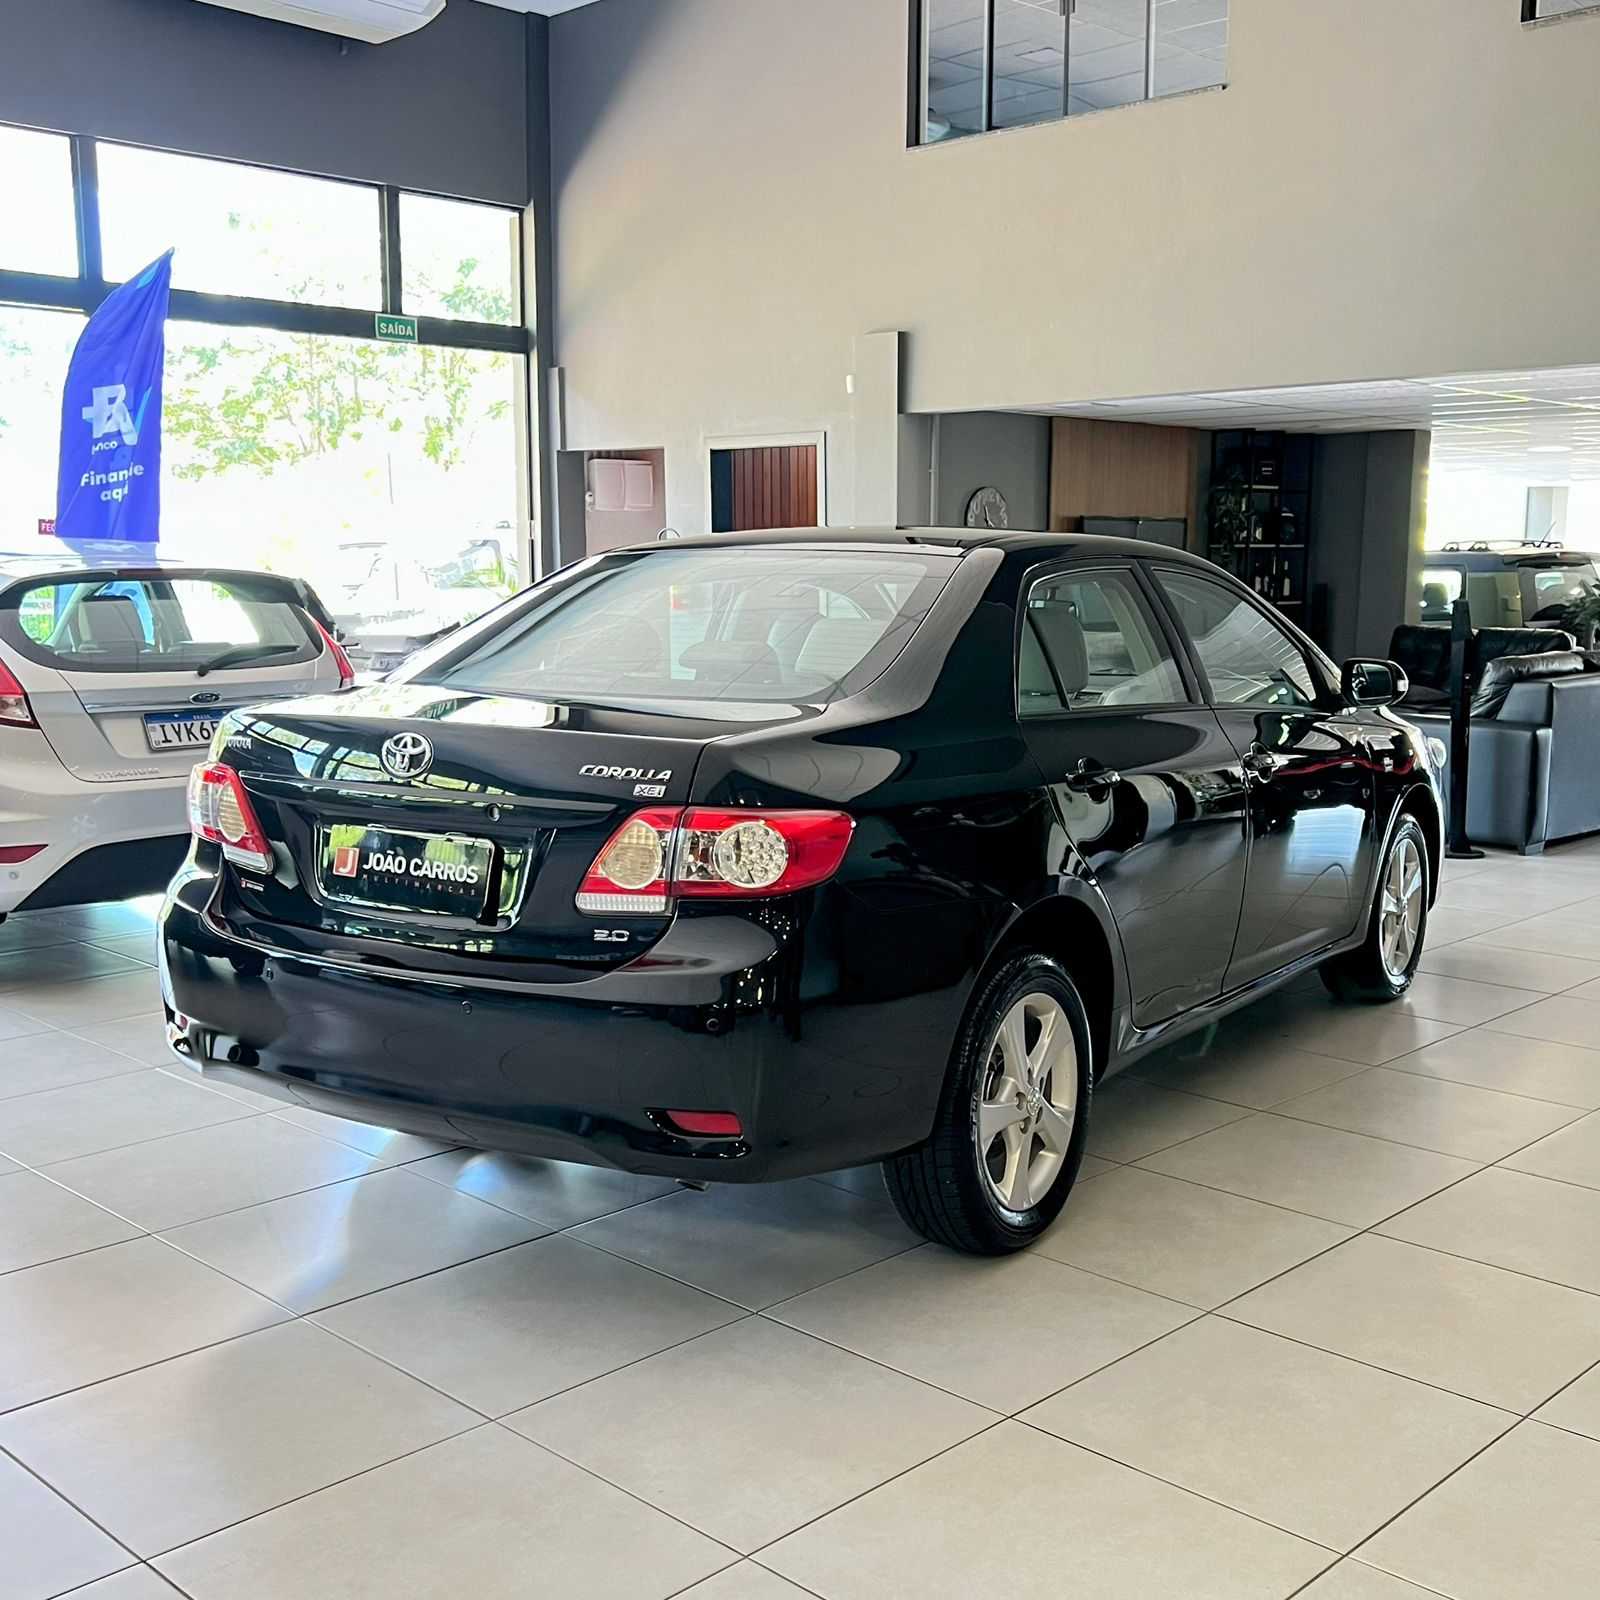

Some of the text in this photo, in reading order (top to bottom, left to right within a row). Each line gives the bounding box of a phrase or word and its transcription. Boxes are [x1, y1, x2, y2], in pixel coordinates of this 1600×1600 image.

[380, 321, 413, 336] SAÍDA
[579, 765, 672, 781] COROLLA
[362, 850, 479, 884] JOÃO CARROS
[594, 929, 629, 941] 2.0
